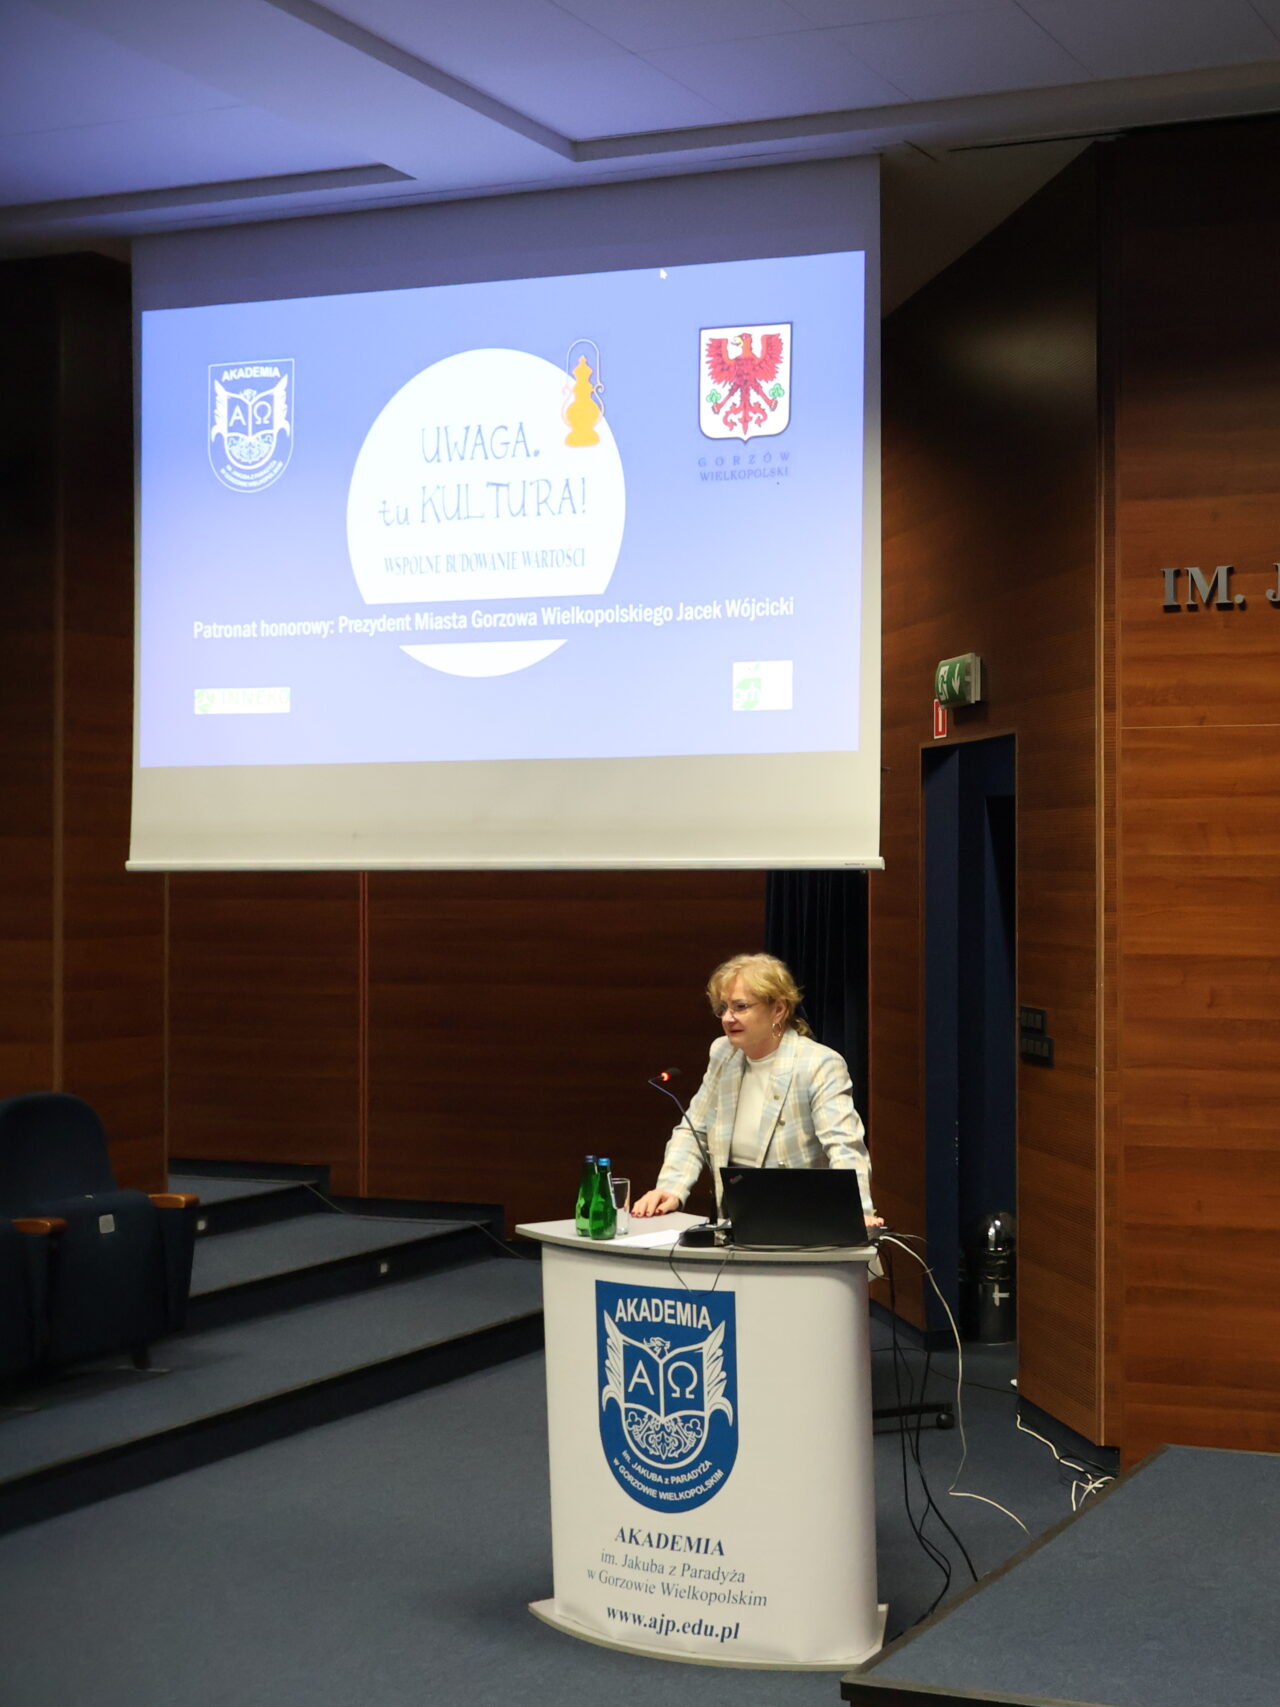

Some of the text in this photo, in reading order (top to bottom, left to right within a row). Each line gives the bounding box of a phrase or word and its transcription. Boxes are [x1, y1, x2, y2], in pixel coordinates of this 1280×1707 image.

[221, 366, 282, 383] AKADEMIA
[421, 421, 540, 463] UWAGA.
[700, 466, 788, 481] WIELKOPOLSKI
[378, 477, 587, 526] tu KULTURA!
[446, 550, 518, 573] BUDOWANIE
[1161, 565, 1245, 607] IM.
[193, 595, 795, 639] Patronat honorowy: Prezydent Miasta Gorzowa Wielkopolskiego Jacek Wójcicki
[615, 1298, 713, 1332] AKADEMIA
[619, 1464, 658, 1498] GORZOWIE
[658, 1468, 724, 1501] WIELKOPOLSKIM
[632, 1462, 663, 1484] JAKUBA
[614, 1525, 725, 1557] AKADEMIA
[600, 1548, 745, 1586] im. Jakuba z Paradyża
[587, 1568, 767, 1608] w Gorzowie Wielkopolskim
[606, 1606, 741, 1643] www.ajp.edu.pl
